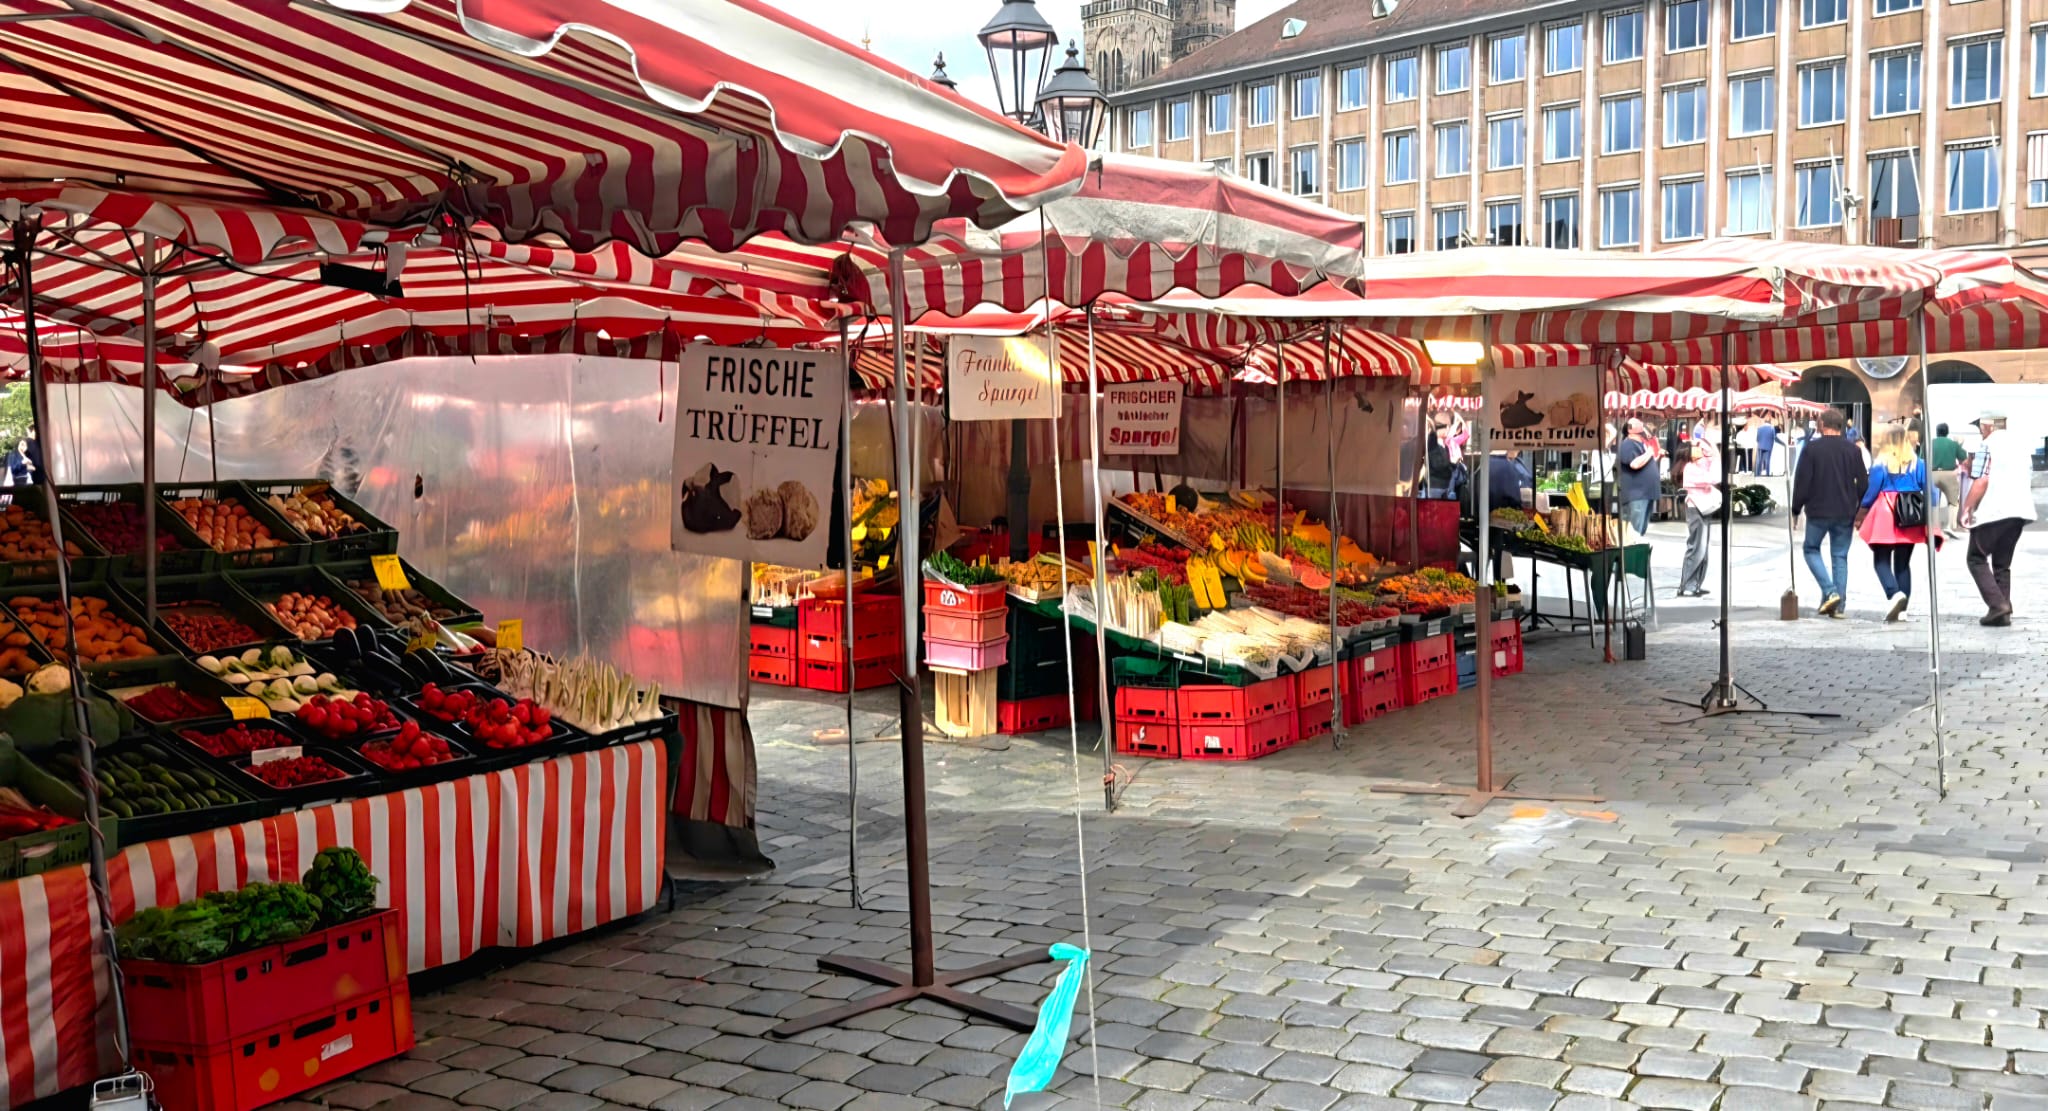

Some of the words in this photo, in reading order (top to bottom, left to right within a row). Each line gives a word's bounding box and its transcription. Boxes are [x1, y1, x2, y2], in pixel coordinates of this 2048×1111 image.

[705, 356, 816, 398] FRISCHE
[1110, 390, 1176, 404] FRISCHER
[686, 404, 830, 450] TRÜFFEL
[1109, 426, 1178, 447] Spargel
[1489, 427, 1542, 440] frische
